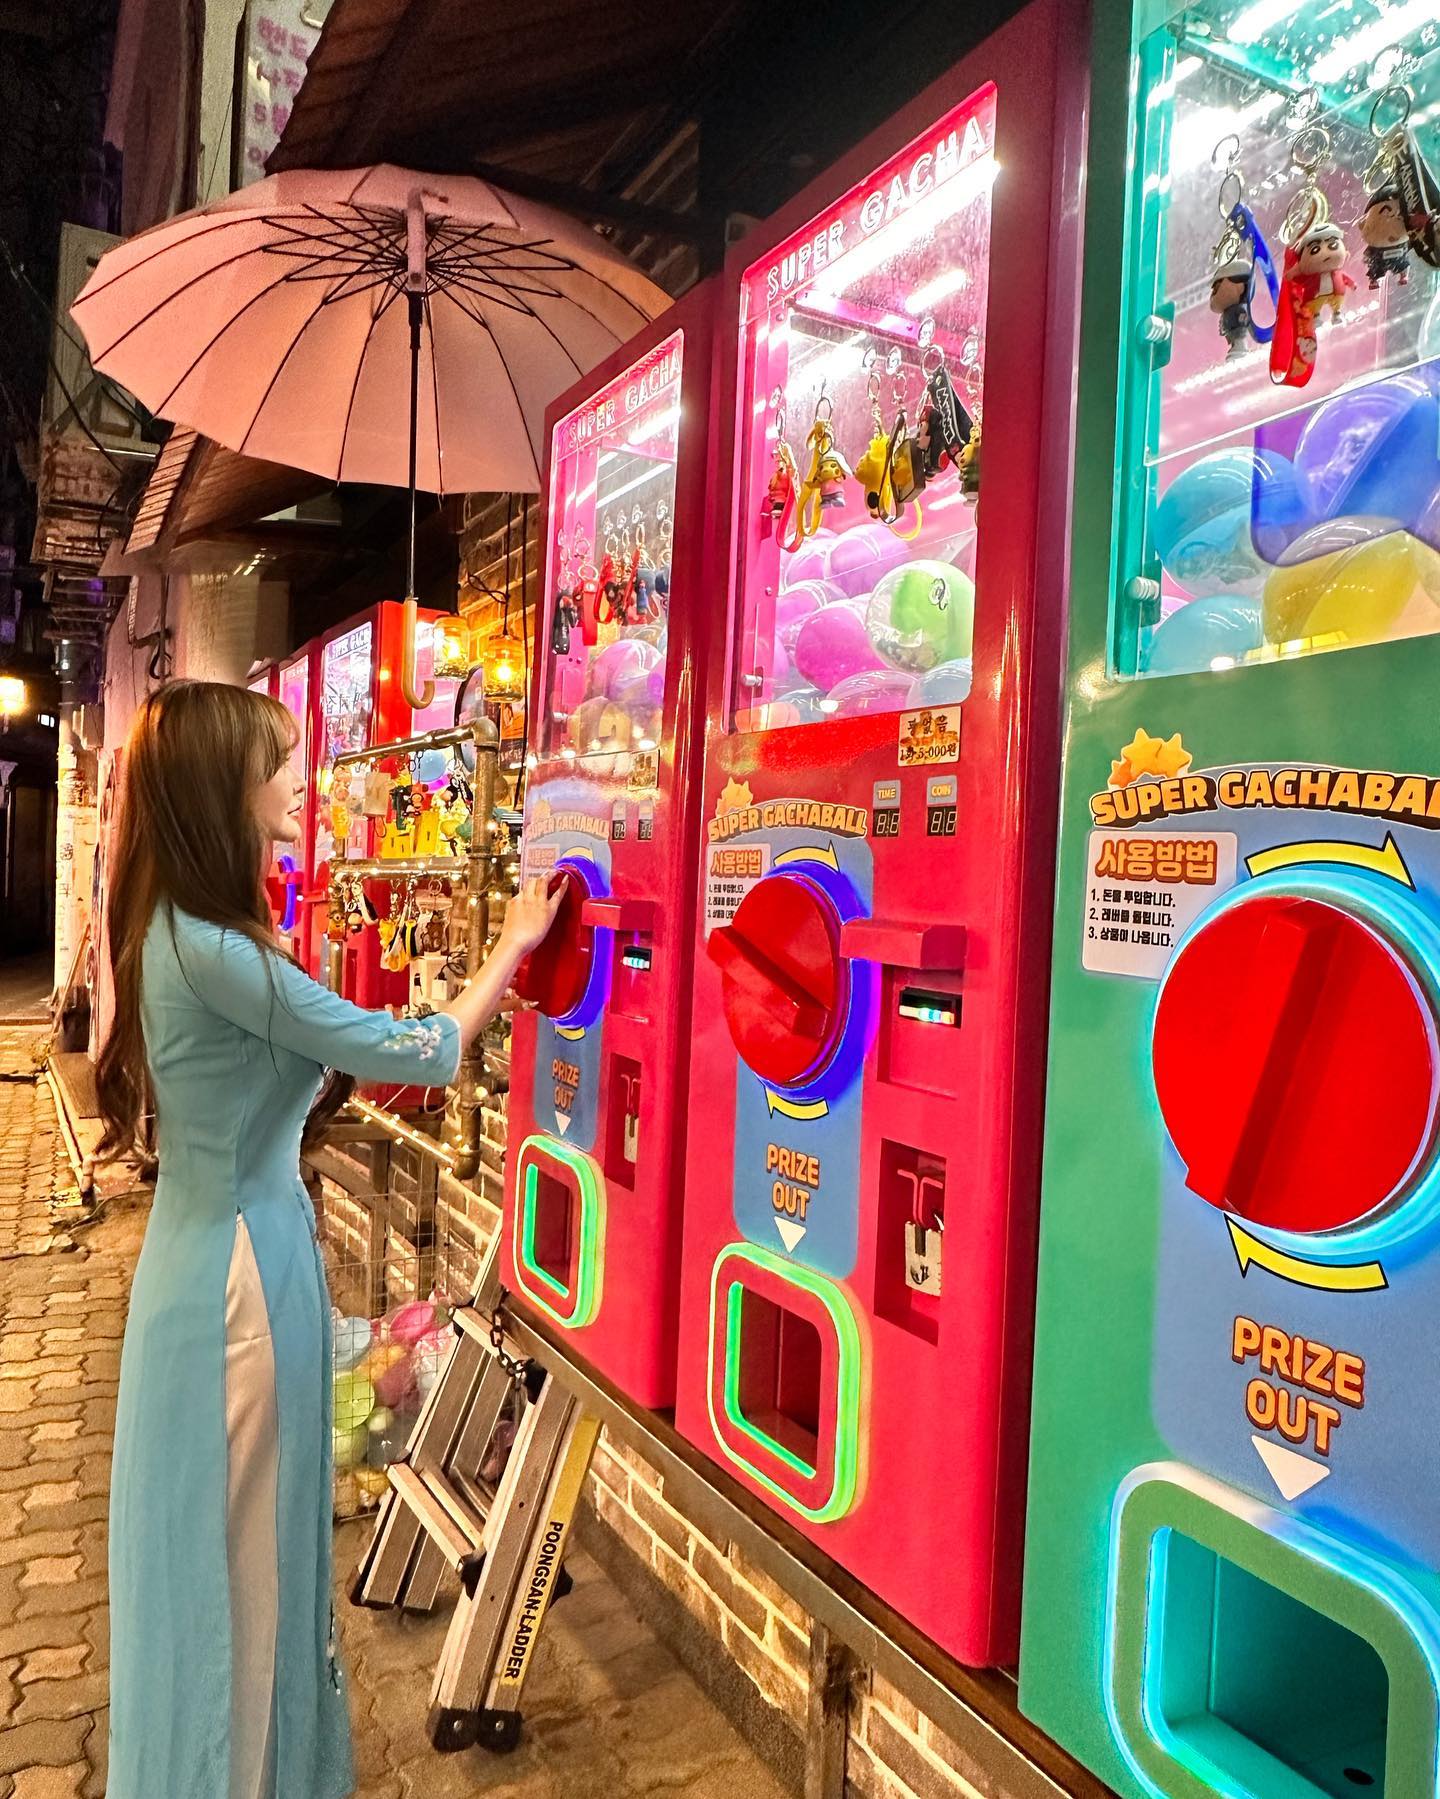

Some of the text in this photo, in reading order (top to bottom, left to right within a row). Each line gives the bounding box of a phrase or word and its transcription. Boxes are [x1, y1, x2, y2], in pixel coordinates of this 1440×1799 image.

[767, 115, 988, 301] SUPER GACHA
[568, 347, 681, 449] SUPER GACHA
[877, 788, 897, 800] TIME
[931, 783, 952, 797] COIN
[1090, 775, 1218, 826] SUPER
[708, 803, 867, 843] SUPER GACHABALL
[710, 848, 762, 878] 사용방법
[1094, 838, 1218, 886] 사용방법
[1089, 907, 1099, 921] 2.
[1090, 888, 1100, 902] 1.
[1088, 926, 1098, 940] 3.
[552, 1058, 580, 1089] PRIZE
[554, 1085, 575, 1113] OUT
[766, 1142, 820, 1190] PRIZE
[771, 1180, 811, 1222] OUT
[1231, 1315, 1366, 1410] PRIZE
[1245, 1377, 1342, 1457] OUT
